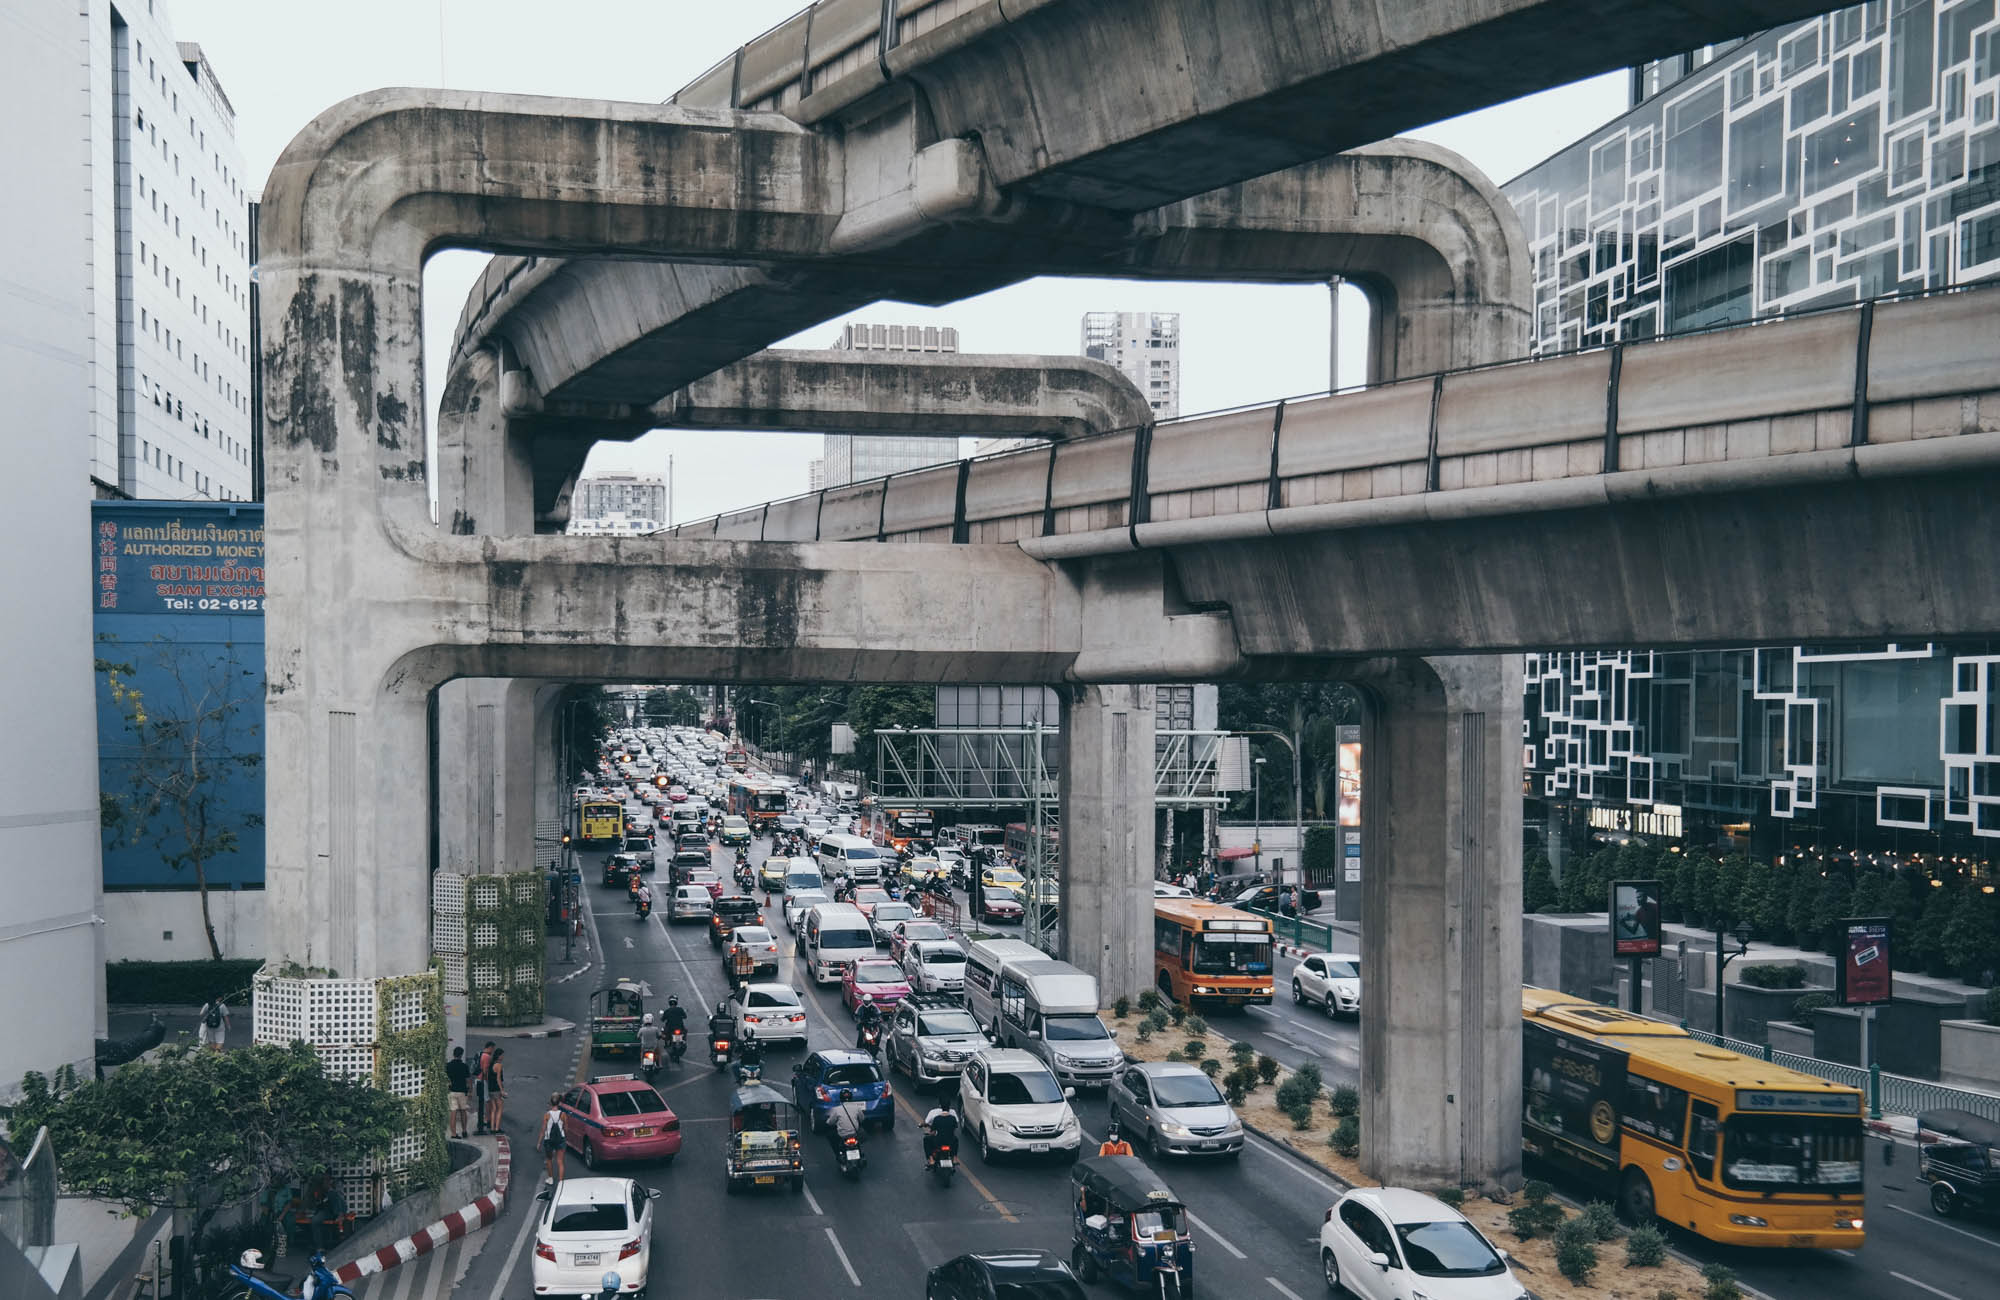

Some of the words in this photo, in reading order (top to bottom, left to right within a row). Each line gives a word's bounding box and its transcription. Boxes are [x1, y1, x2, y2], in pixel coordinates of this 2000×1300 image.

[123, 544, 212, 556] AUTHORIZED
[216, 545, 265, 557] MONEY
[156, 583, 202, 596] SIAM
[206, 585, 265, 597] EXCHA
[164, 598, 194, 610] Tel:
[198, 599, 258, 611] 02-612
[1589, 807, 1631, 831] JAMIE'S
[1638, 812, 1682, 837] ITALIAN
